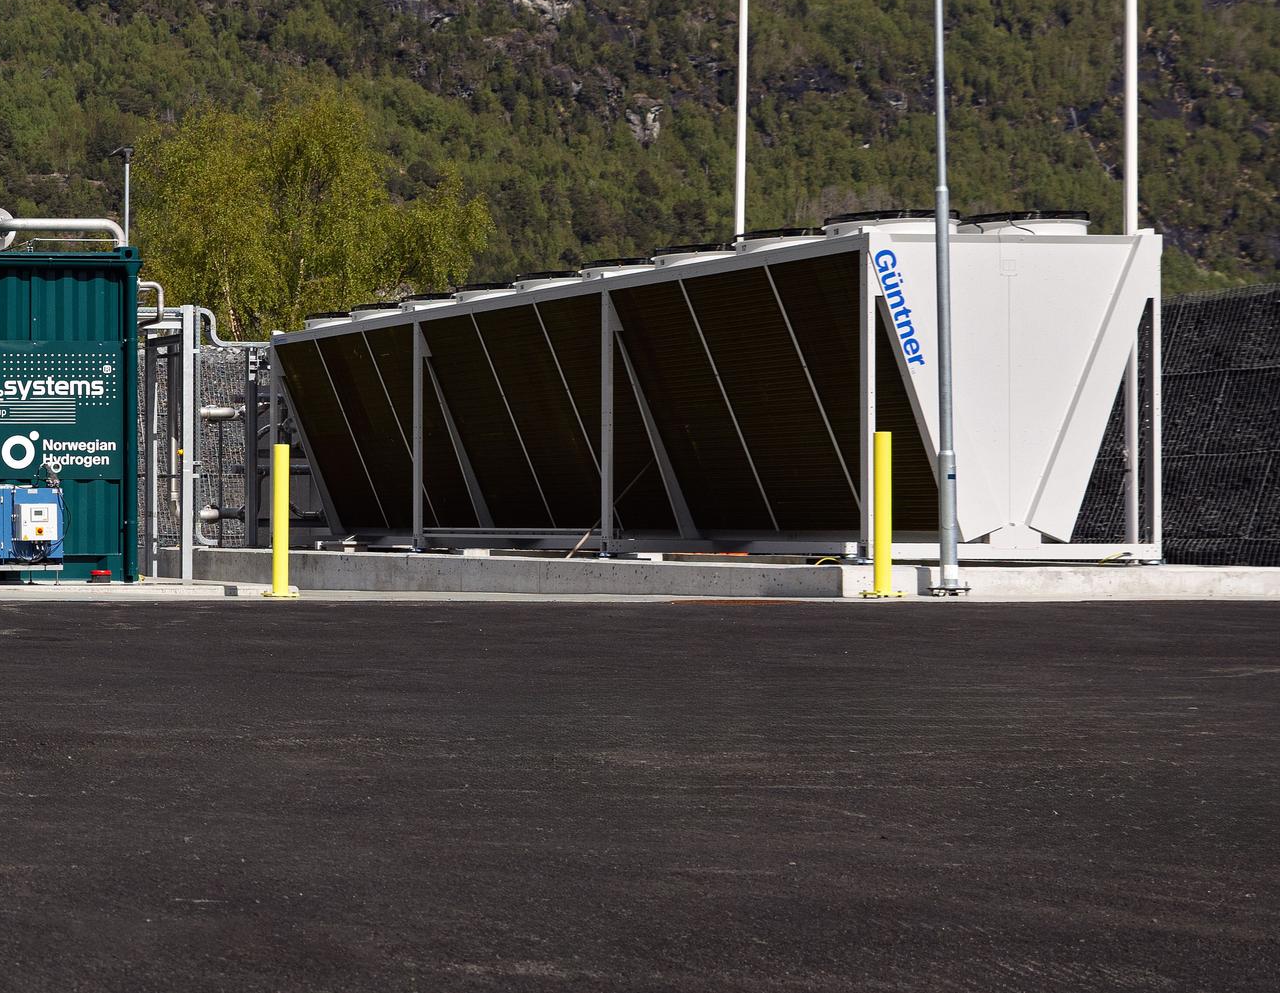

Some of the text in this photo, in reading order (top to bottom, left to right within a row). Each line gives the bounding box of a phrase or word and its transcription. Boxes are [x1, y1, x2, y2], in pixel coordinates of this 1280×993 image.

[875, 249, 925, 365] Güntner
[42, 439, 117, 454] Norwegian
[42, 453, 110, 468] Hydrogen
